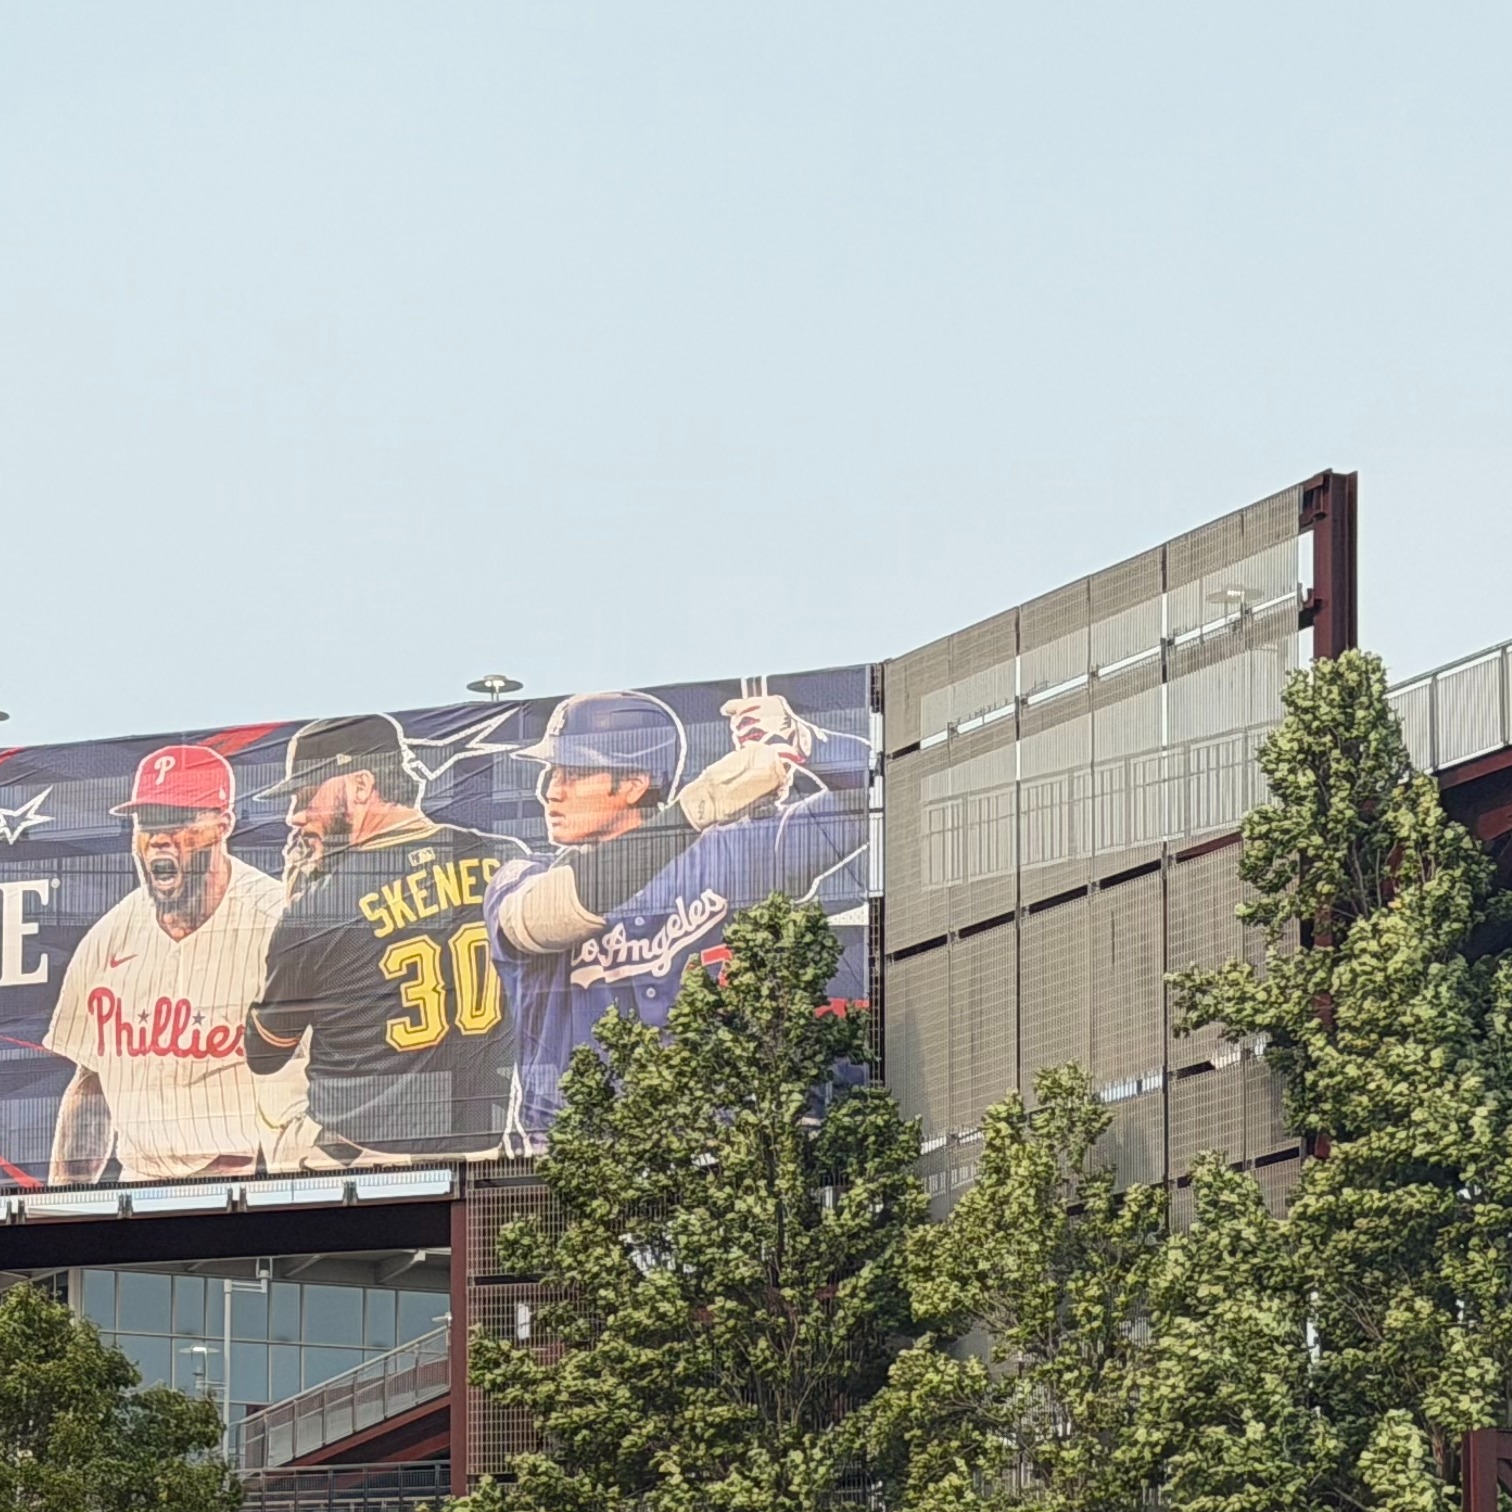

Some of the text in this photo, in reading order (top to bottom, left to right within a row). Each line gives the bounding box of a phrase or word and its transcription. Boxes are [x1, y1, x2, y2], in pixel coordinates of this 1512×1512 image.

[154, 755, 176, 786] P
[601, 888, 728, 976] Angeles
[378, 920, 502, 1053] 30
